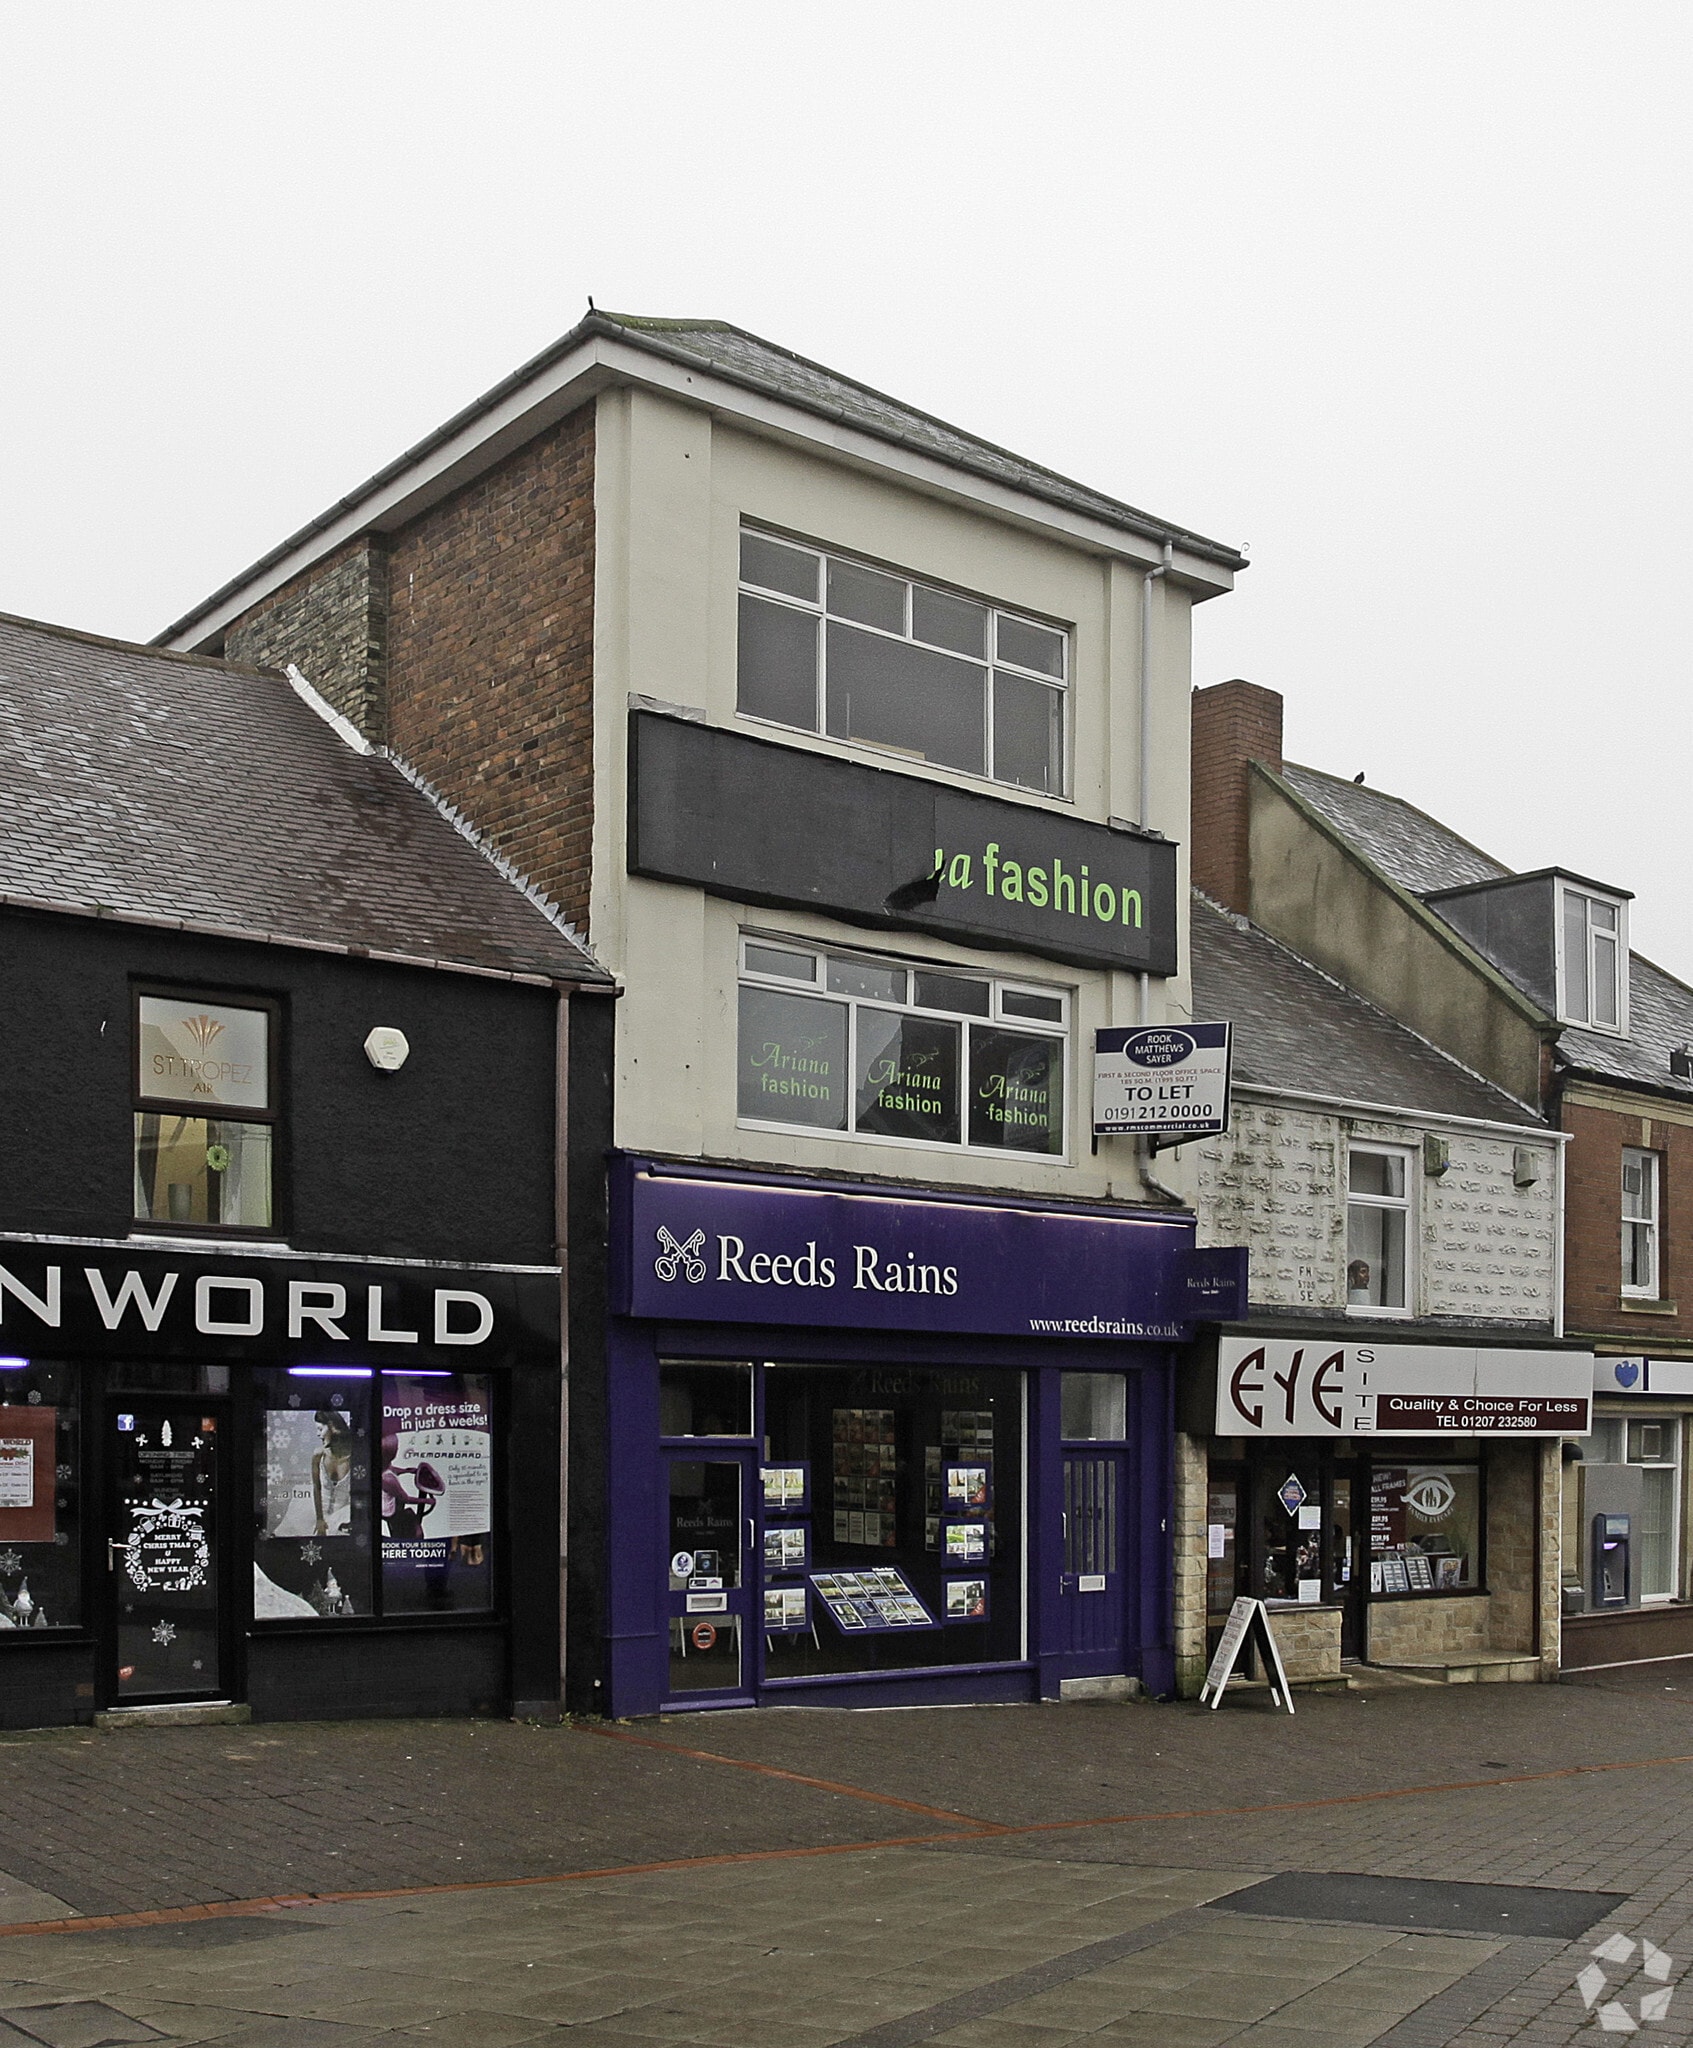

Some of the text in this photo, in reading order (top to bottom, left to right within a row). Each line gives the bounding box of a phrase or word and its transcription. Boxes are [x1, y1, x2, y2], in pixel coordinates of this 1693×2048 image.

[983, 842, 1142, 929] fashion
[1146, 1034, 1172, 1044] ROOK
[1134, 1043, 1185, 1055] MATTHEWS
[750, 1042, 830, 1076] Ariana
[1145, 1054, 1172, 1064] SAYER
[868, 1059, 942, 1091] Ariana
[1152, 1069, 1174, 1077] FLOOR
[1175, 1068, 1198, 1076] OFFICE
[1200, 1067, 1221, 1075] SPACE
[193, 1082, 214, 1094] AIR
[761, 1073, 830, 1101] fashion
[979, 1074, 1047, 1105] Ariana
[1125, 1084, 1194, 1101] TO LET
[878, 1090, 942, 1115] fashion
[988, 1102, 1048, 1127] fashion
[1104, 1104, 1212, 1120] 0191 212 0000
[1104, 1121, 1210, 1132] www.rmscommercial.co.uk
[716, 1234, 959, 1296] Reeds Rains
[1029, 1315, 1180, 1338] www.reedsrains.co.uk
[1230, 1346, 1345, 1430] EYE
[1353, 1348, 1376, 1431] SITE
[383, 1401, 481, 1419] Drop a dress size
[1389, 1398, 1578, 1413] Quality & Choice For Less
[401, 1413, 488, 1432] in just 6 weeks!
[1436, 1415, 1537, 1428] TEL 01207 232580
[293, 1489, 311, 1499] tan
[381, 1548, 446, 1558] HERE TODAY!
